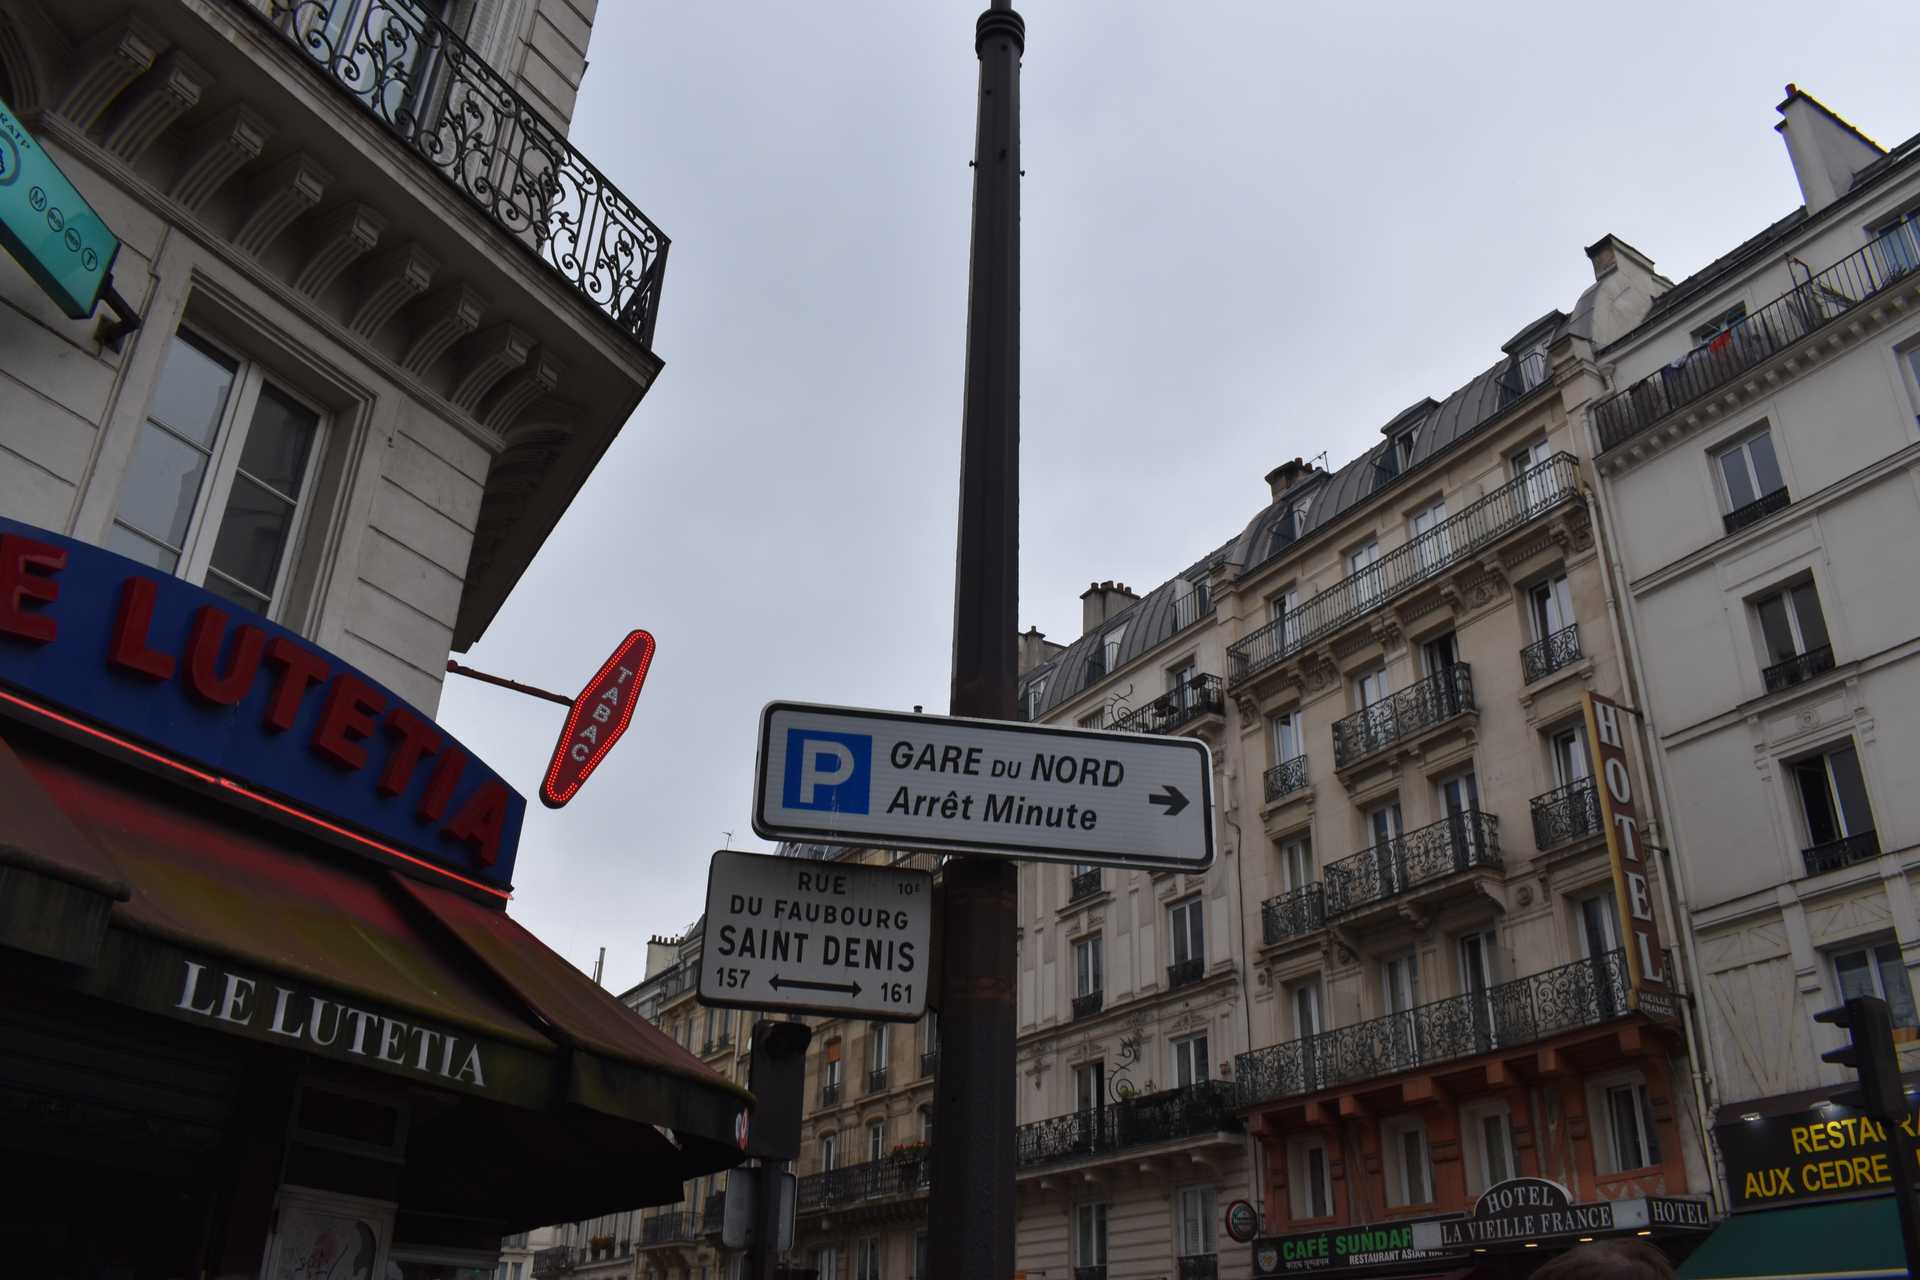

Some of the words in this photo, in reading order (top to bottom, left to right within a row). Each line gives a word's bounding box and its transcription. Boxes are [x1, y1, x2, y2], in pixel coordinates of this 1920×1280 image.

[108, 576, 513, 866] LUTETIA
[571, 666, 632, 762] TABAC
[890, 741, 983, 777] GARE
[991, 759, 1022, 779] DU
[1031, 752, 1125, 788] NORD
[887, 786, 972, 822] Arrêt
[983, 793, 1098, 831] Minute
[1596, 702, 1664, 983] HOTEL
[798, 872, 847, 896] RUE
[730, 894, 763, 916] DU
[774, 899, 909, 930] FAUBOURG
[718, 924, 809, 963] SAINT
[823, 934, 915, 973] DENIS
[715, 967, 751, 990] 157
[880, 982, 913, 1004] 161
[175, 961, 257, 1027] LE
[267, 986, 488, 1089] LUTETIA
[1744, 1166, 1795, 1200] AUX
[1802, 1153, 1893, 1193] CEDRE
[1487, 1185, 1554, 1214] HOTEL
[1653, 1200, 1708, 1226] HOTEL
[1442, 1224, 1464, 1245] LA
[1468, 1213, 1537, 1243] VIEILLE
[1541, 1205, 1613, 1233] FRANCE
[1283, 1235, 1329, 1262] CAFÉ
[1349, 1249, 1400, 1266] RESTAURANT
